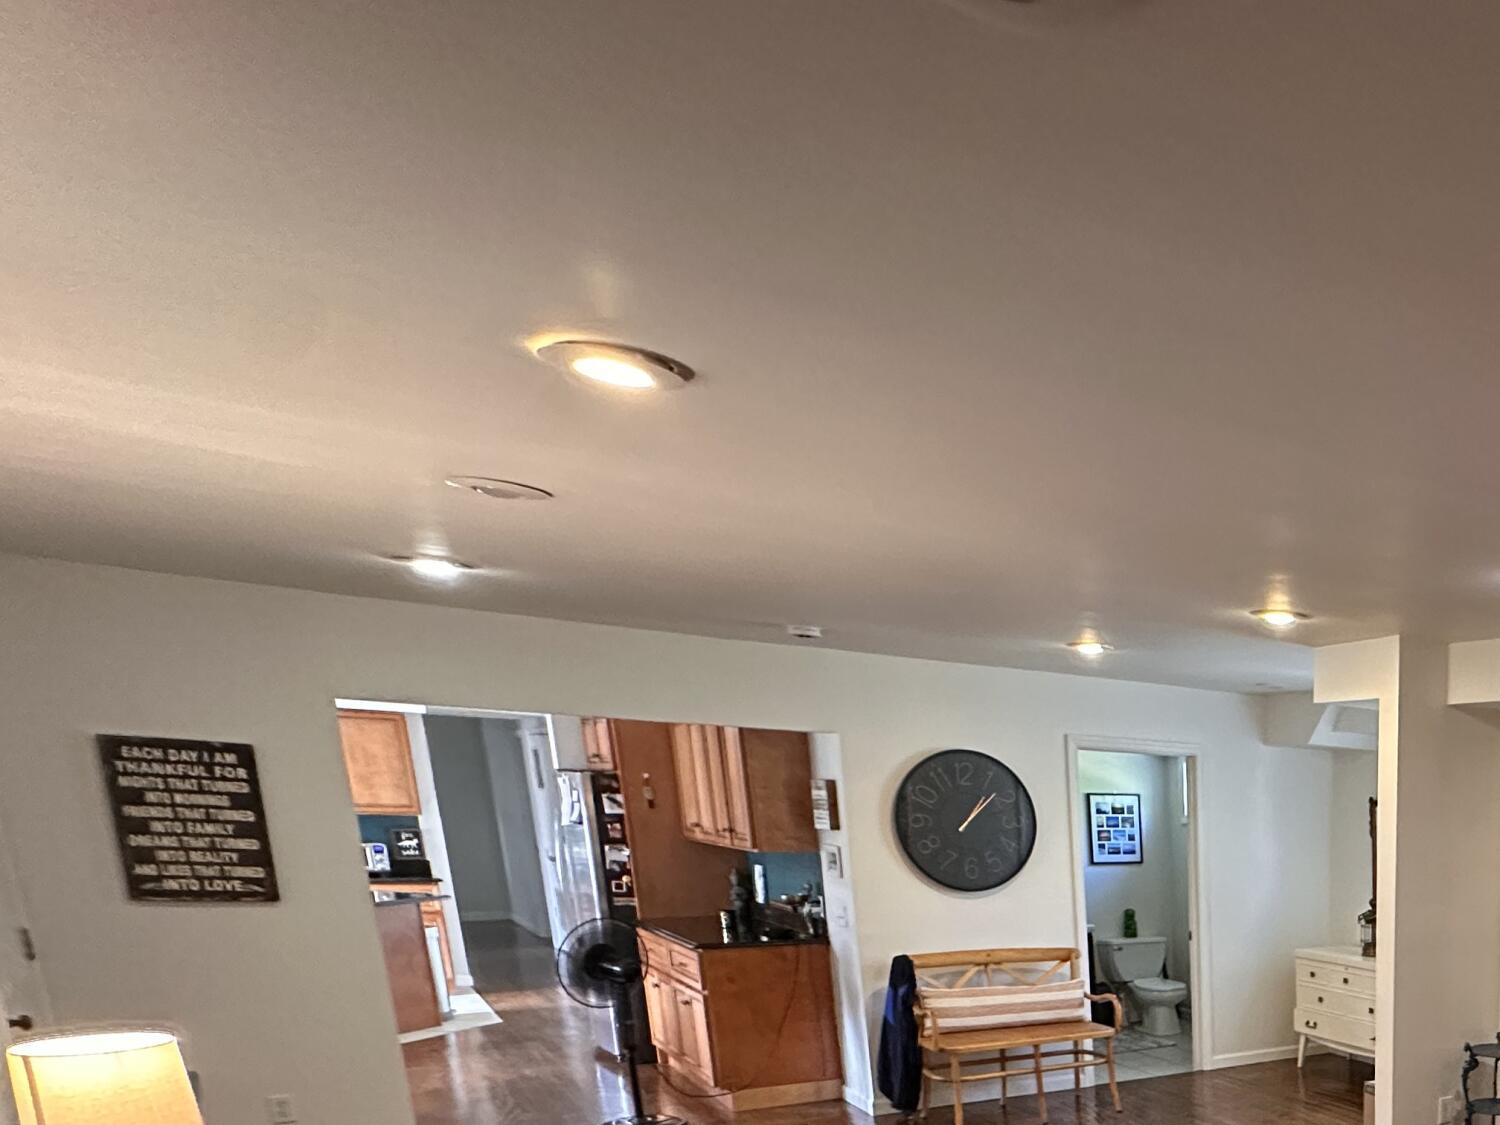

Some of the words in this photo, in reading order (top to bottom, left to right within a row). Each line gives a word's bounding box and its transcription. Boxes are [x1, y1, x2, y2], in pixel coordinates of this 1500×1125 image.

[121, 746, 164, 759] EACH
[167, 749, 198, 762] DAY
[202, 751, 210, 762] I
[214, 752, 238, 764] AM
[113, 760, 210, 777] THANKFUL
[214, 766, 248, 779] FOR
[954, 762, 974, 785] 12
[166, 777, 199, 791] THAT
[929, 768, 953, 792] 11
[983, 771, 993, 791] 1
[912, 785, 939, 809] 10
[149, 821, 184, 833] INTO
[186, 822, 235, 835] FAMILY
[912, 813, 933, 828] 9
[918, 835, 940, 854] 8
[940, 849, 958, 870] 7
[965, 857, 978, 879] 6
[984, 850, 1002, 872] 5
[162, 879, 200, 891] INTO
[203, 879, 244, 892] LOVE
